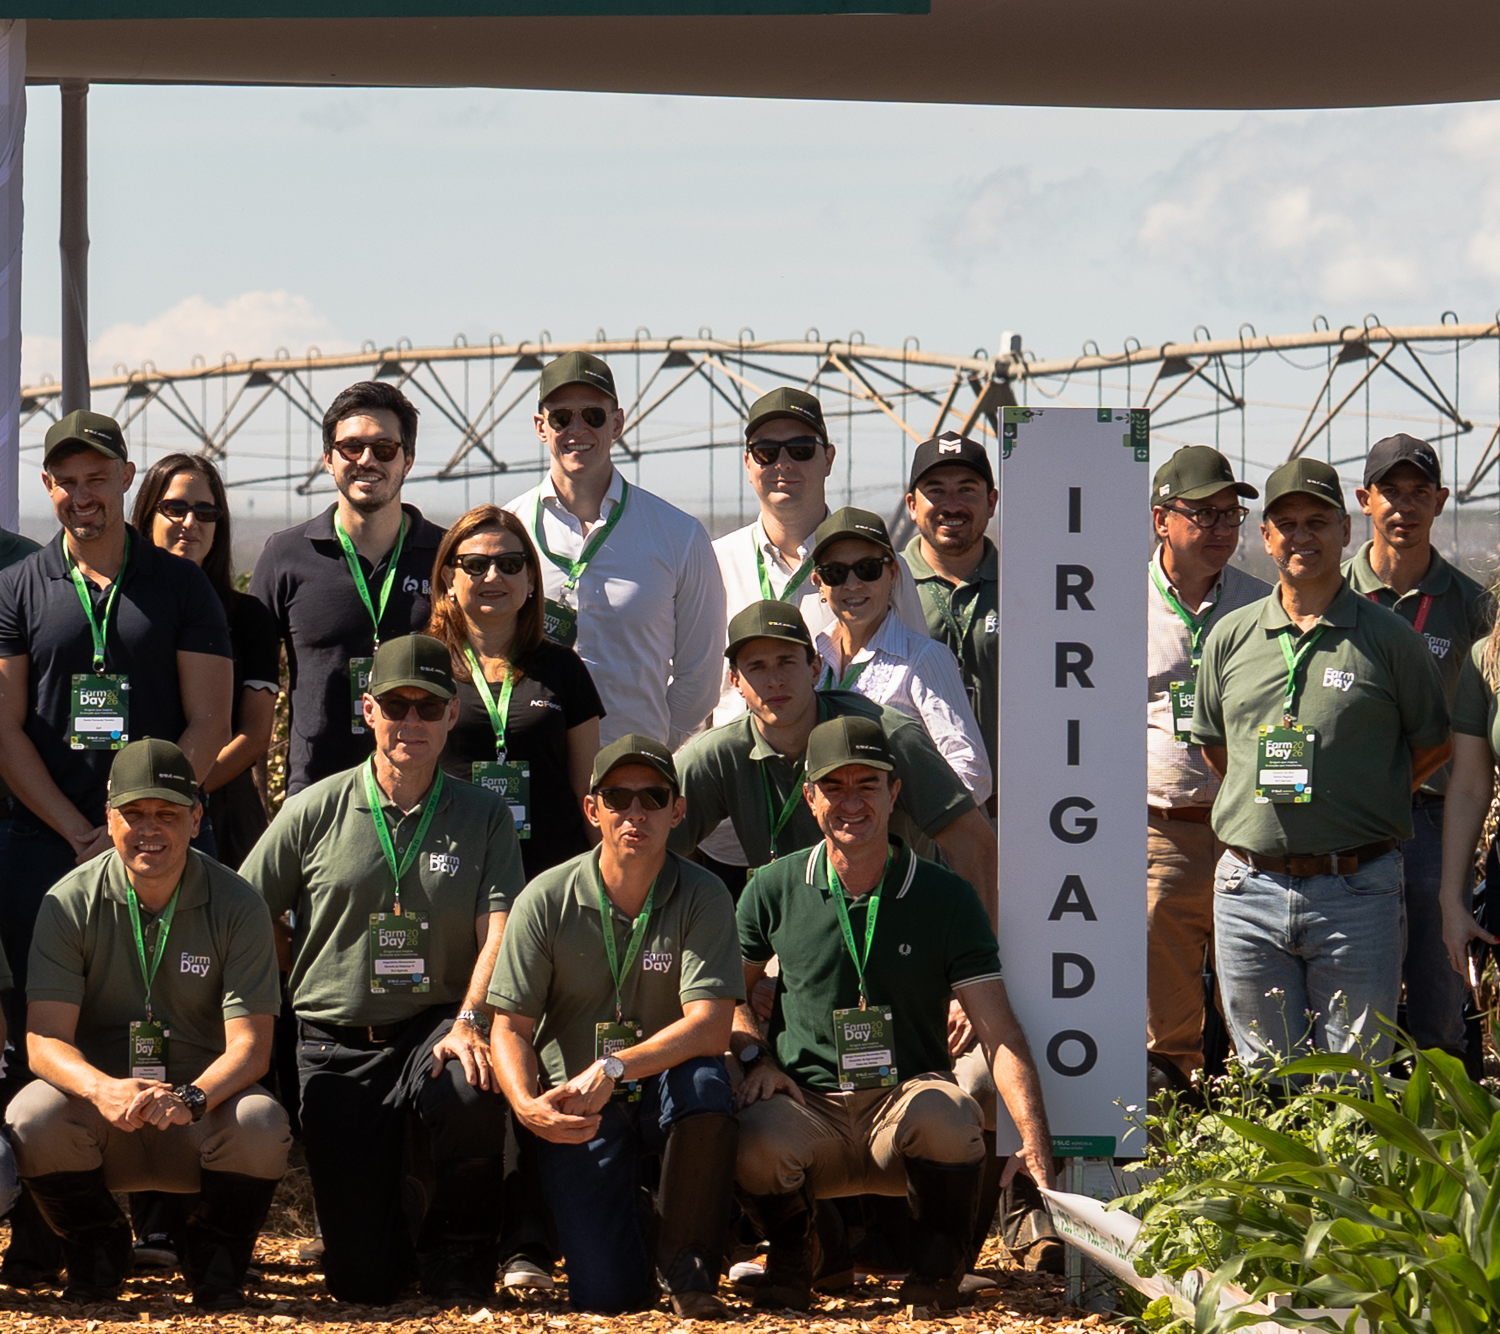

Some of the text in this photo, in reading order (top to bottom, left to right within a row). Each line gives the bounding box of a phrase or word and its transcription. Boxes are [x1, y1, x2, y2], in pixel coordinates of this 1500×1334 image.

[1324, 668, 1354, 681] Farm
[1323, 675, 1354, 691] Day
[80, 688, 106, 696] Farm
[80, 696, 105, 707] Day
[1266, 740, 1292, 749] Farm
[1266, 748, 1291, 760] Day
[1045, 486, 1098, 1076] IRRIGADO
[430, 853, 459, 864] Farm
[430, 858, 459, 876] Day
[379, 929, 406, 937] Farm
[379, 936, 405, 948] Day
[182, 952, 210, 963] Farm
[643, 951, 672, 961] Farm
[180, 960, 209, 977] Day
[643, 959, 671, 973] Day
[844, 1022, 871, 1032] Farm
[845, 1029, 870, 1042] Day
